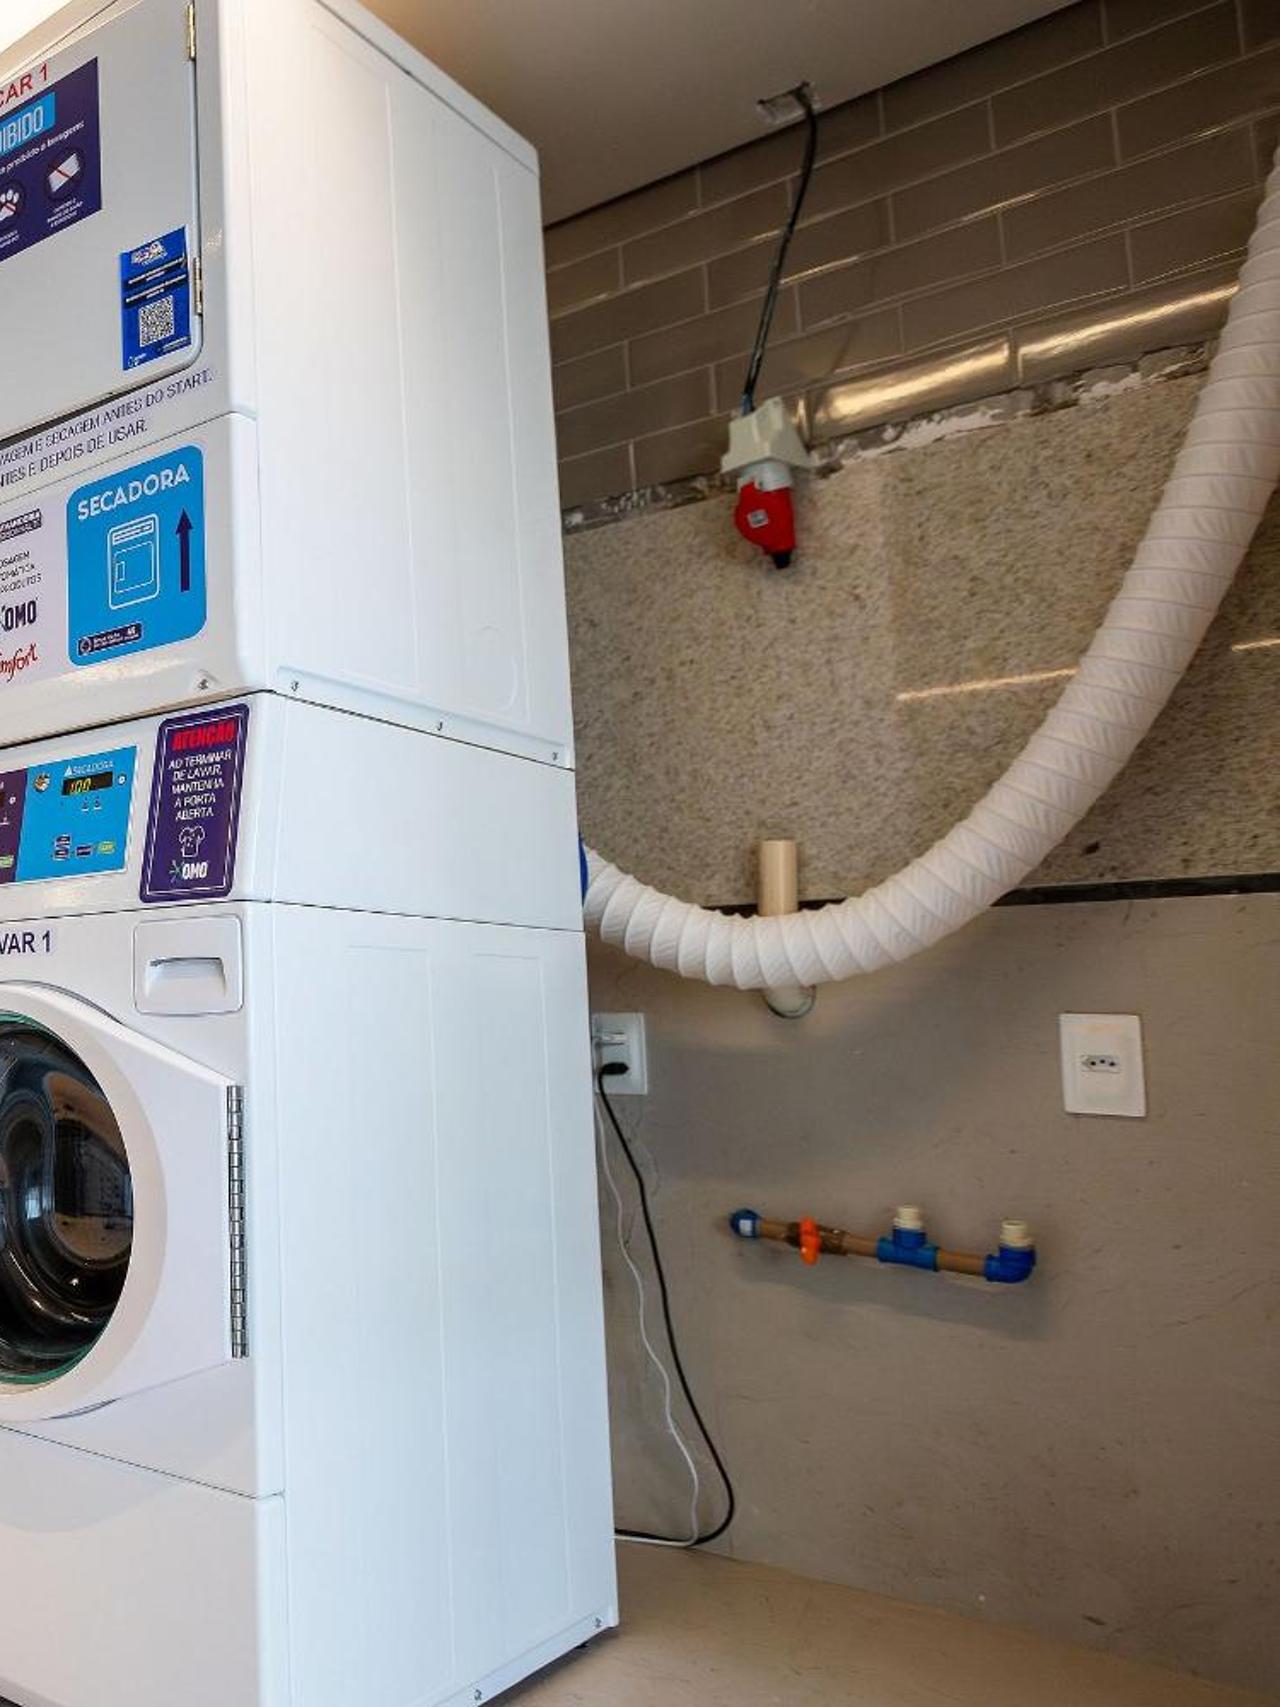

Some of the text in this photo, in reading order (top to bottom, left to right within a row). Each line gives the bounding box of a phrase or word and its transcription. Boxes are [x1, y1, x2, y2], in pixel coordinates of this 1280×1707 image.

[39, 63, 49, 82] 1
[34, 437, 43, 452] E
[45, 411, 101, 447] SECAGEM
[103, 396, 143, 424] ANTES
[146, 388, 164, 407] DO
[28, 461, 36, 476] E
[40, 442, 84, 472] DEPOIS
[88, 435, 105, 454] DE
[108, 418, 148, 446] USAR.
[77, 463, 190, 521] SECADORA
[4, 599, 38, 632] OMO
[173, 769, 187, 782] DE
[174, 793, 216, 809] A PORTA
[175, 807, 214, 821] ABERTA
[182, 861, 209, 880] OMO
[42, 930, 52, 953] 1
